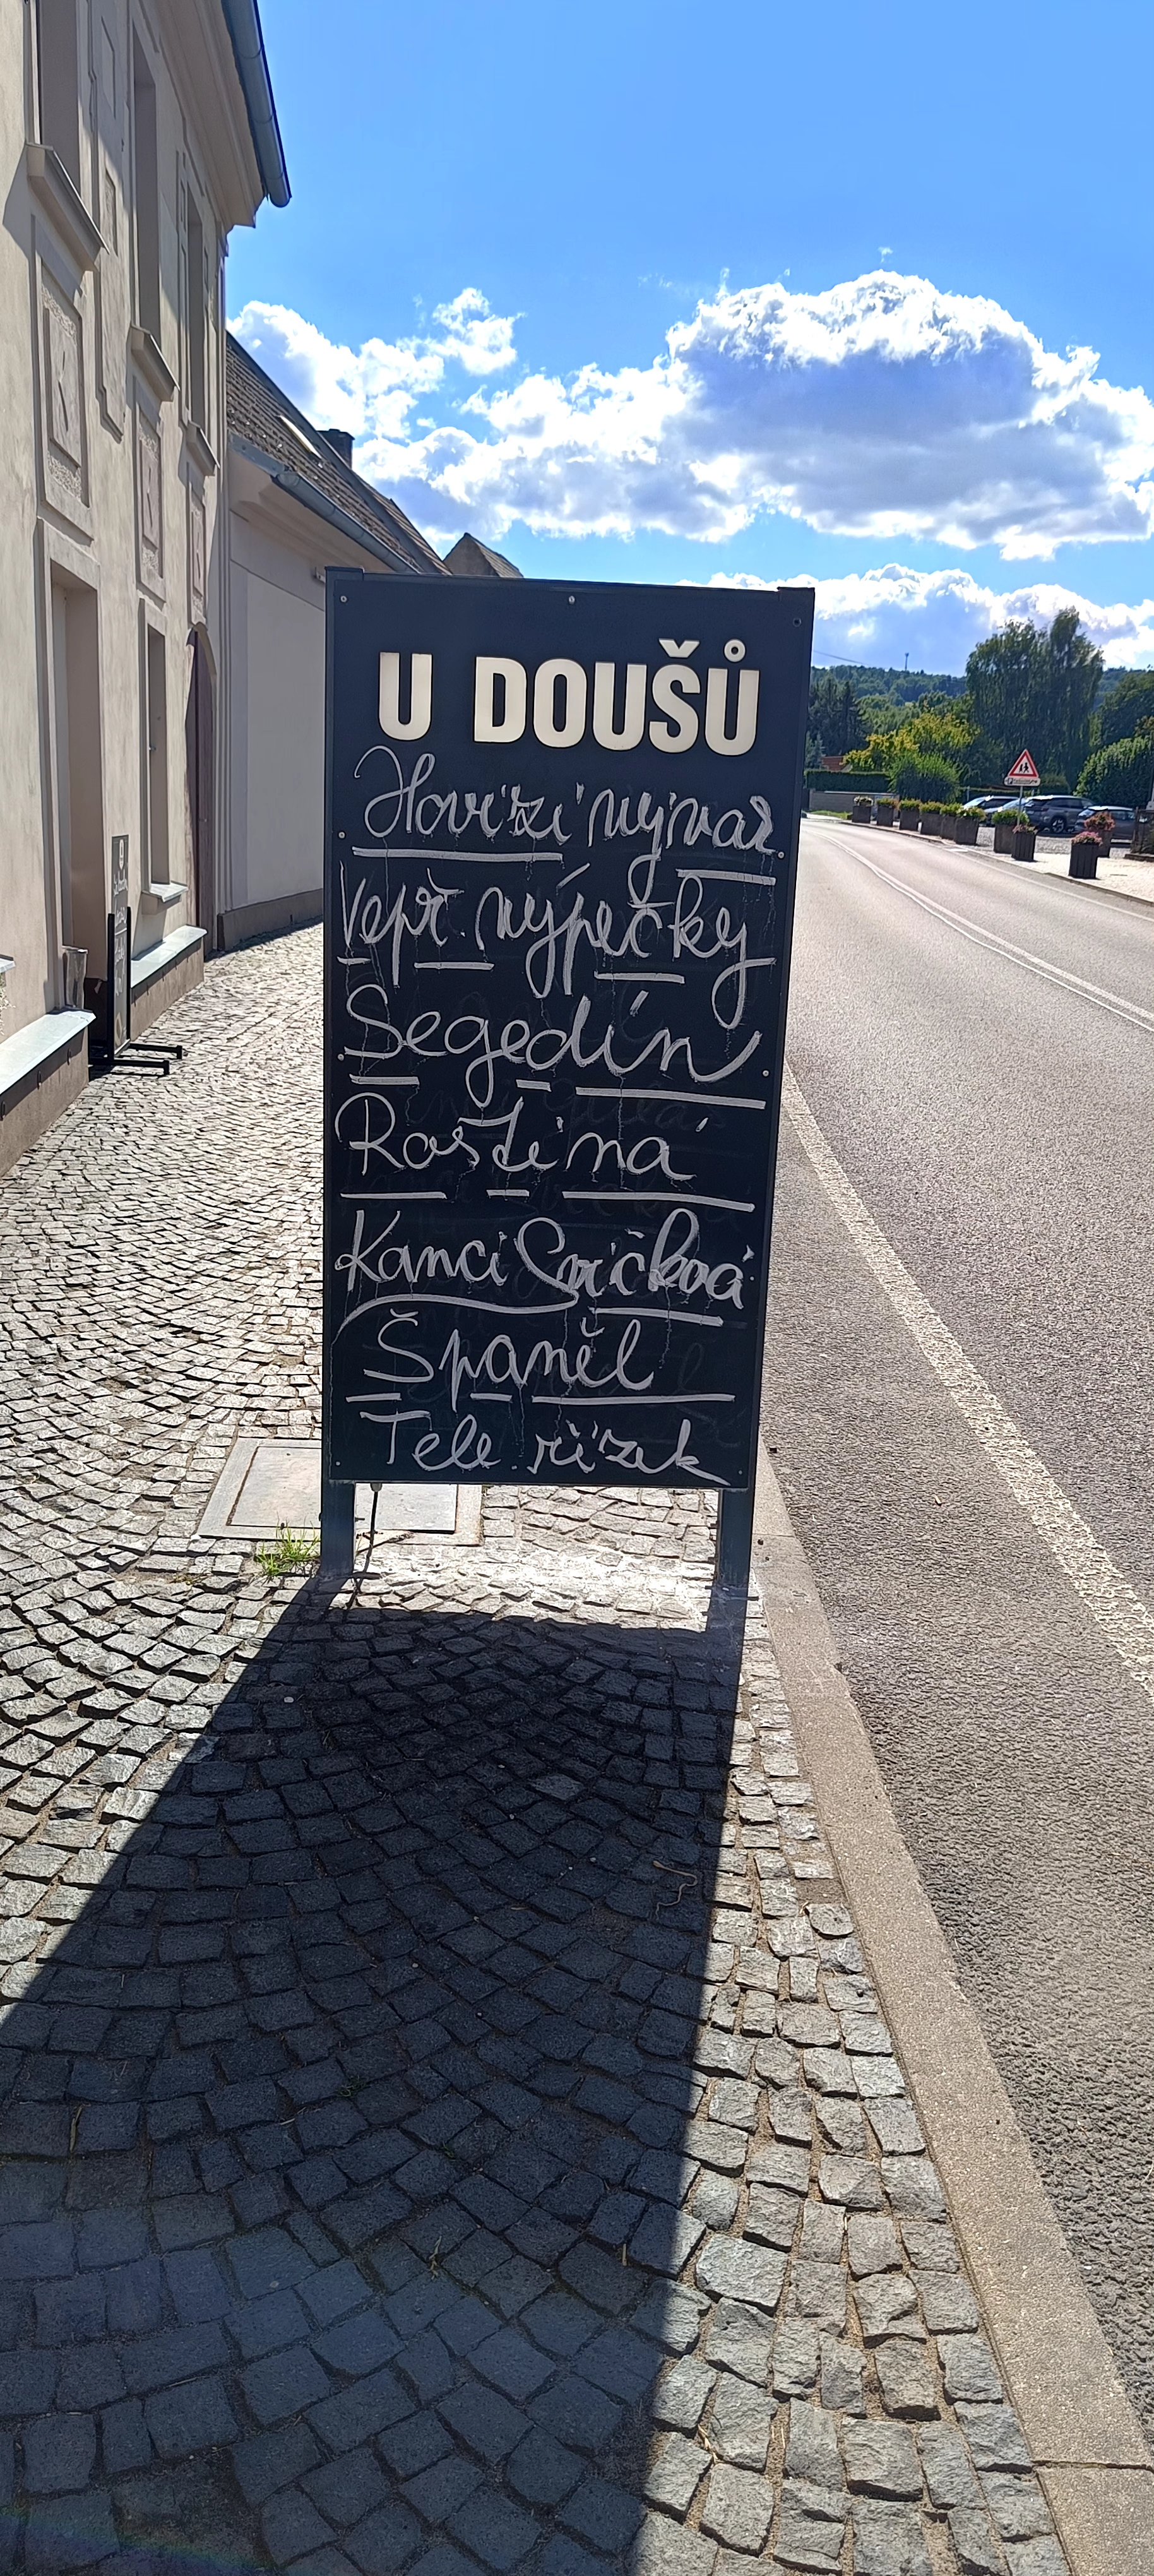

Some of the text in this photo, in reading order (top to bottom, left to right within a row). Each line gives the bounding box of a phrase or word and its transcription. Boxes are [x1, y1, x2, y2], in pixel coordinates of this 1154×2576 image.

[379, 638, 759, 756] U DOUŠŮ
[364, 1308, 654, 1412] Španěl
